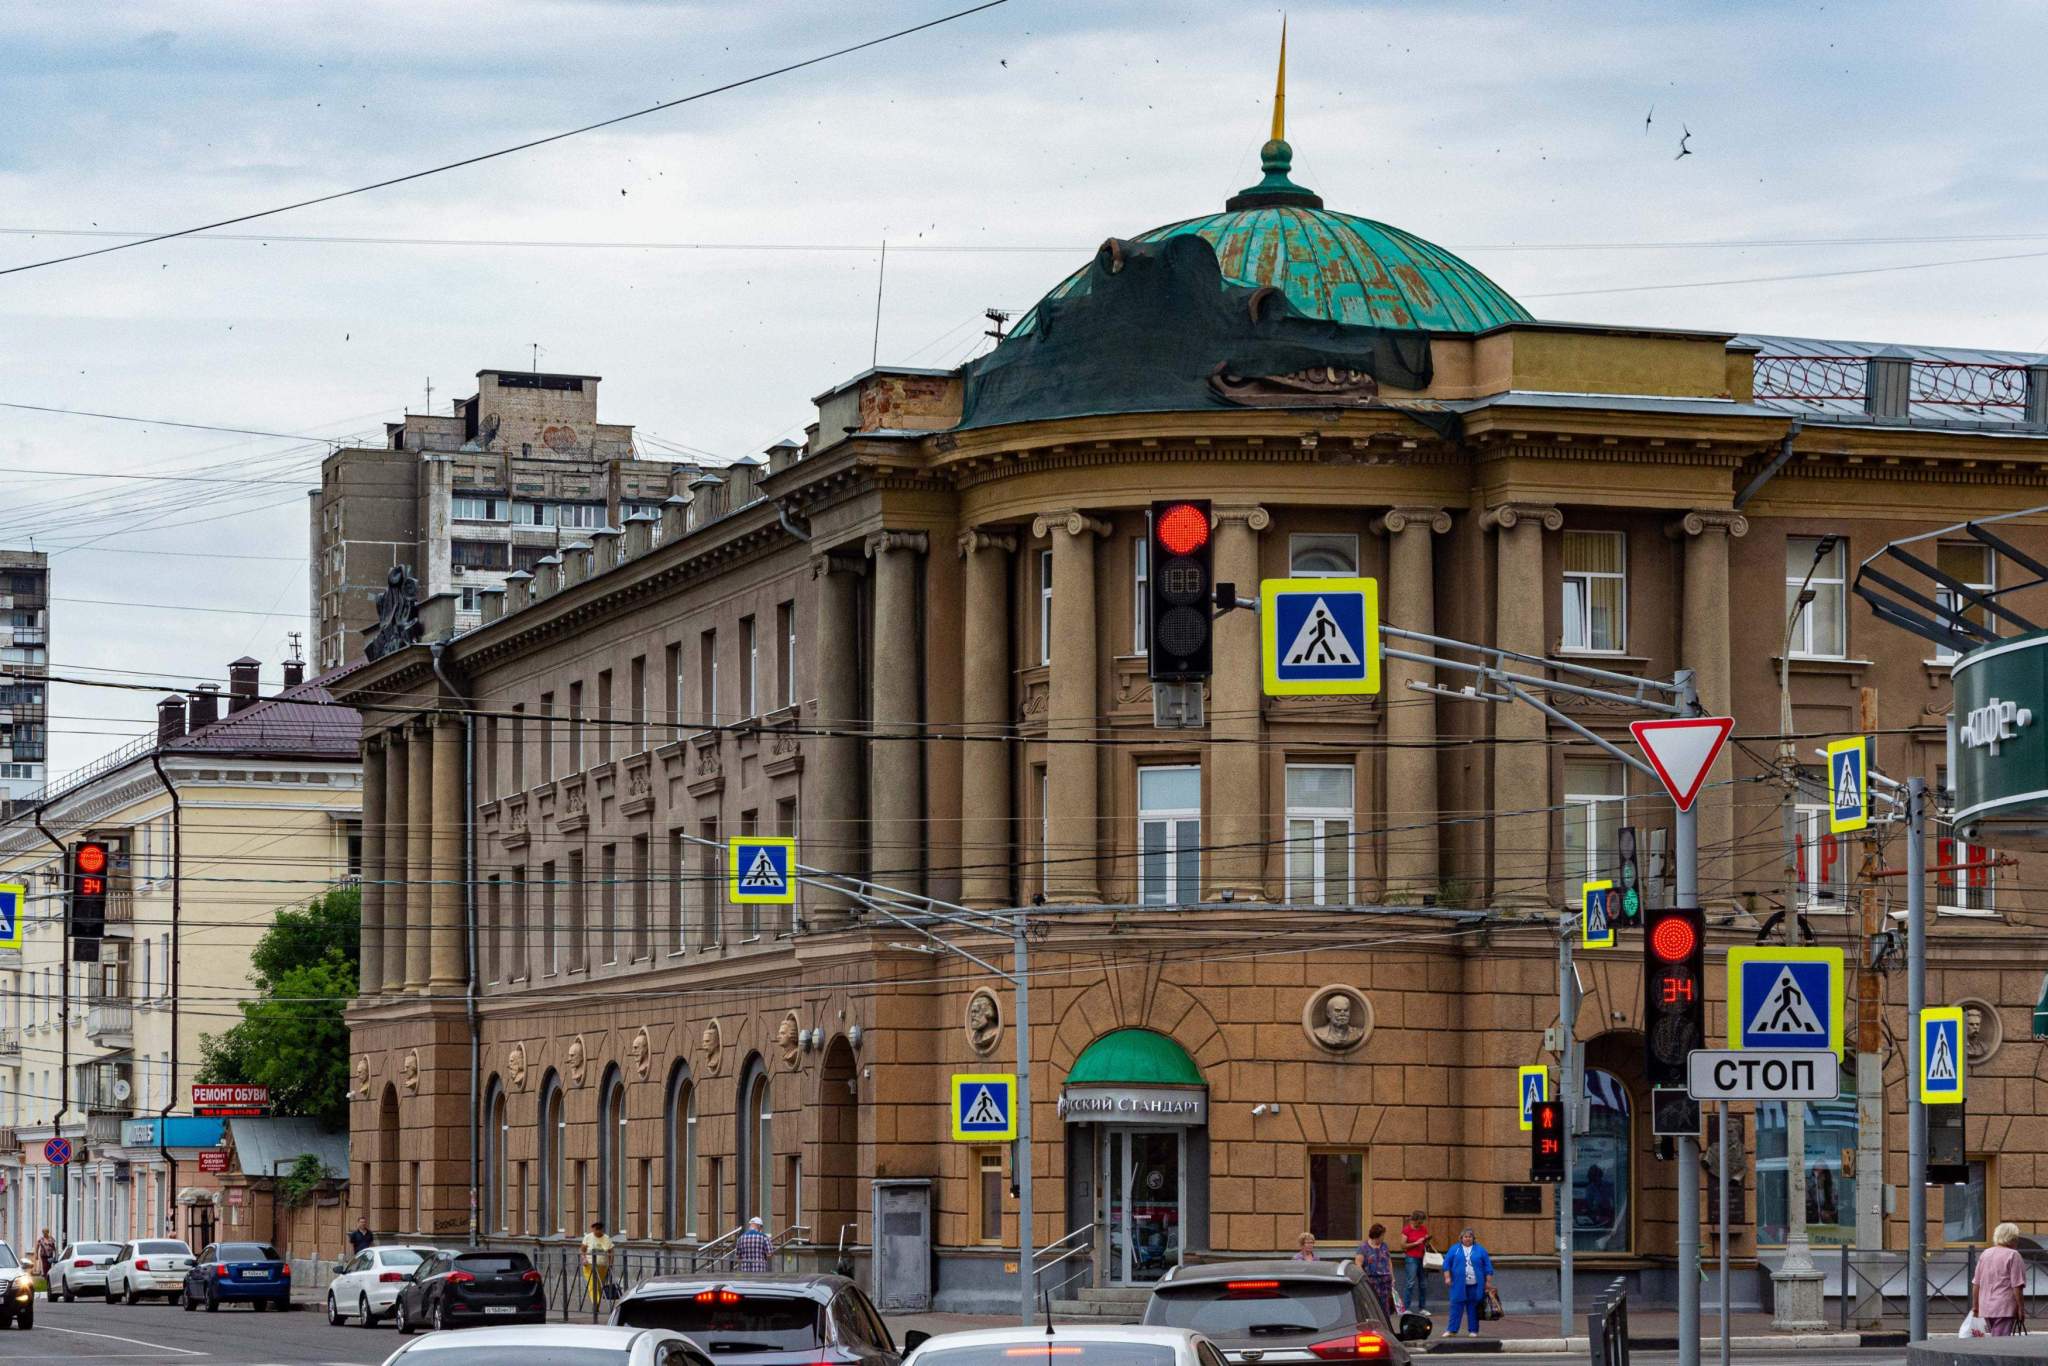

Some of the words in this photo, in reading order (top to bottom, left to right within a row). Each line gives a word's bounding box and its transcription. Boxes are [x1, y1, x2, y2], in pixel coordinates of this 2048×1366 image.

[83, 879, 100, 893] 34
[1663, 978, 1693, 1003] 34
[1713, 1059, 1814, 1091] СТОП
[194, 1088, 233, 1101] РЕМОНТ
[235, 1088, 267, 1101] ОБУВИ
[1541, 1139, 1558, 1153] 34
